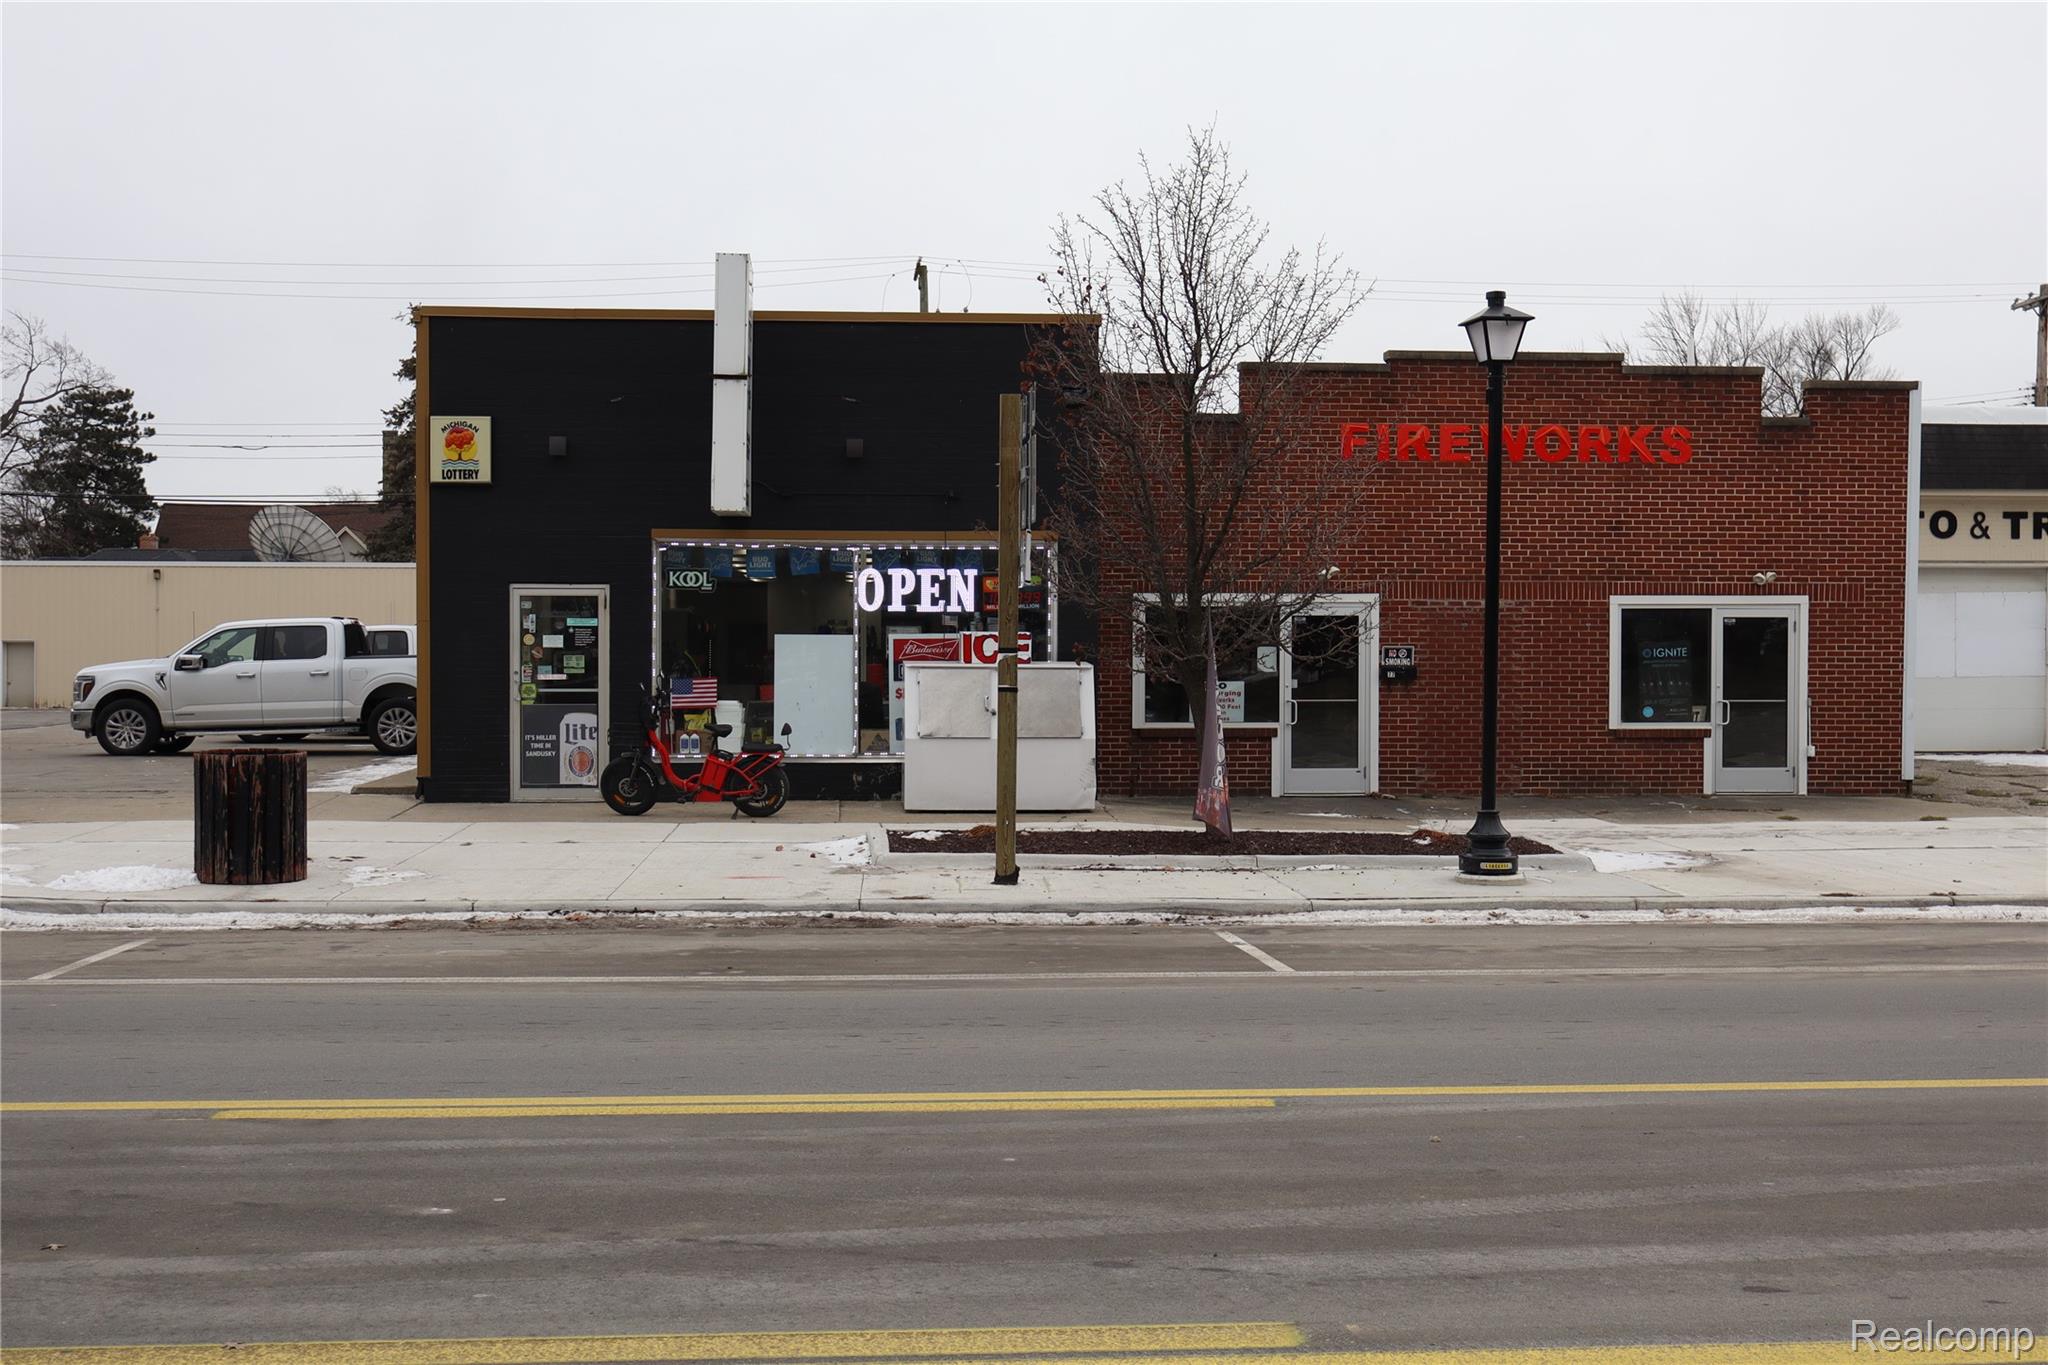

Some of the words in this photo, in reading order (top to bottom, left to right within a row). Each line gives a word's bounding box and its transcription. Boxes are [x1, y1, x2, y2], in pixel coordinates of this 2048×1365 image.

[441, 421, 479, 433] MICHIGAN
[1339, 423, 1693, 465] FIREWORKS
[441, 469, 479, 480] LOTTERY
[1969, 511, 1991, 540] &
[668, 570, 713, 587] KOOL
[857, 568, 978, 613] OPEN
[904, 643, 954, 655] Budweiser
[1653, 647, 1688, 657] IGNITE
[1385, 658, 1411, 666] SMOKING
[565, 723, 597, 745] Lite
